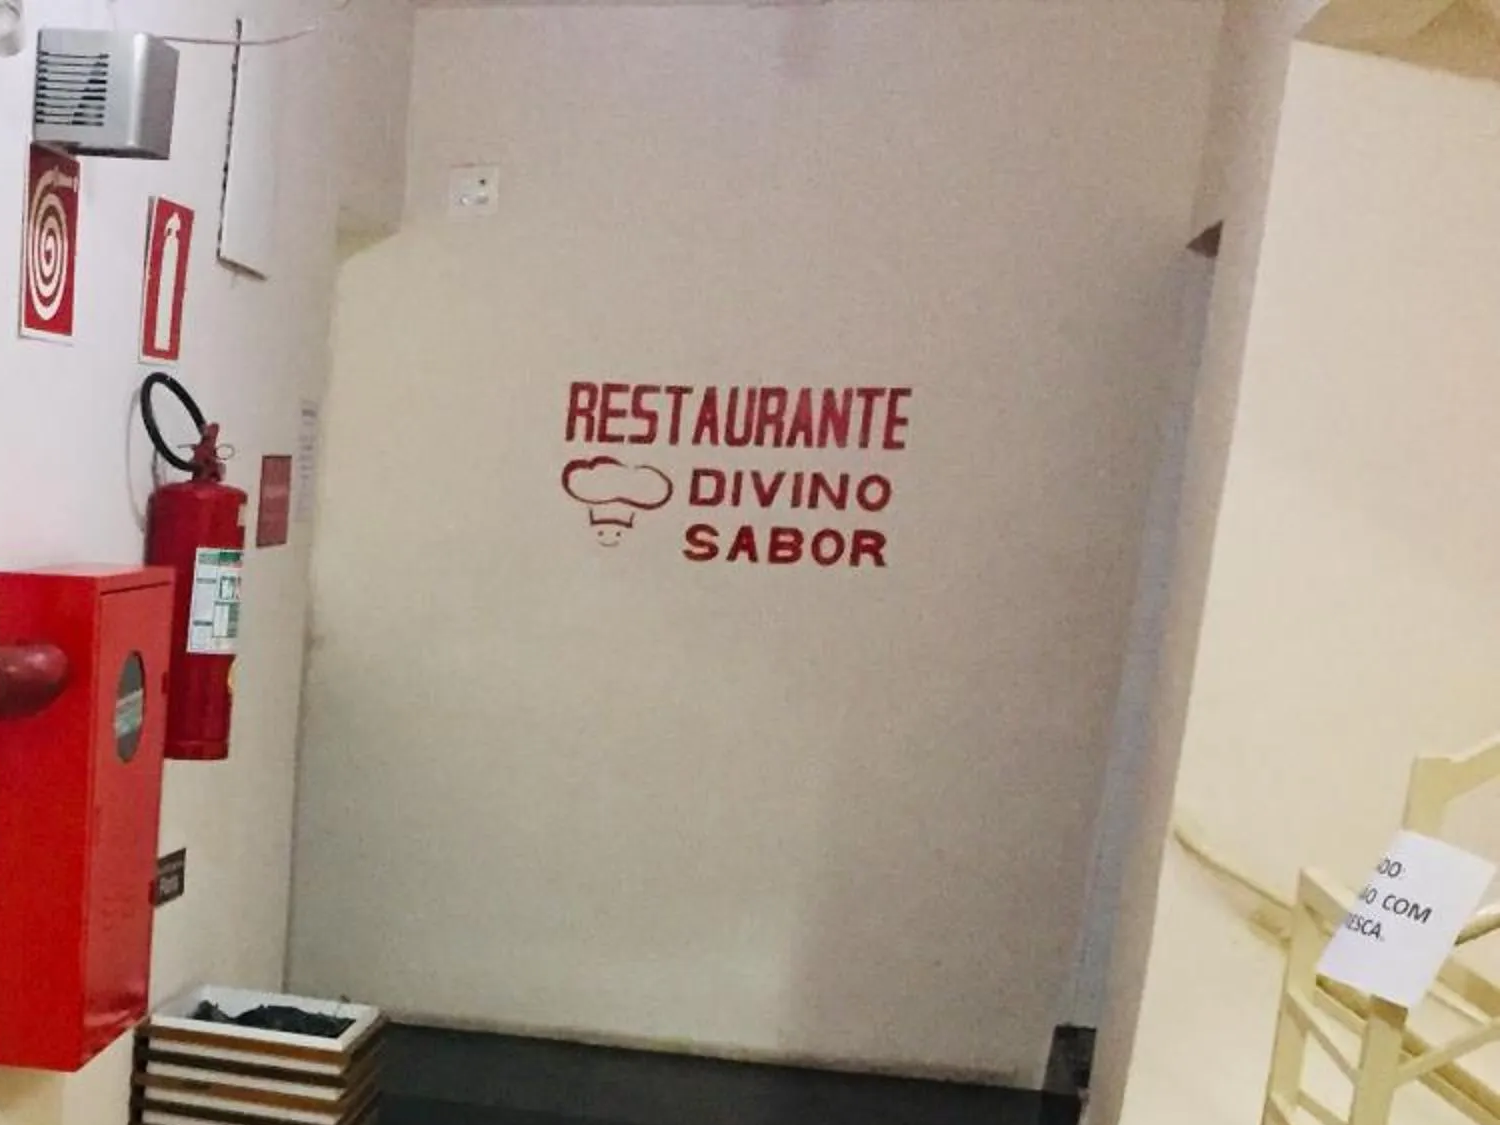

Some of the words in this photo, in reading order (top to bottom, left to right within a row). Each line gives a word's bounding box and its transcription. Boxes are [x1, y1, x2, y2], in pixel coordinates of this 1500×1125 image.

[565, 381, 912, 450] RESTAURANTE
[689, 468, 893, 512] DIVINO
[682, 523, 887, 567] SABOR
[1381, 893, 1433, 924] COM
